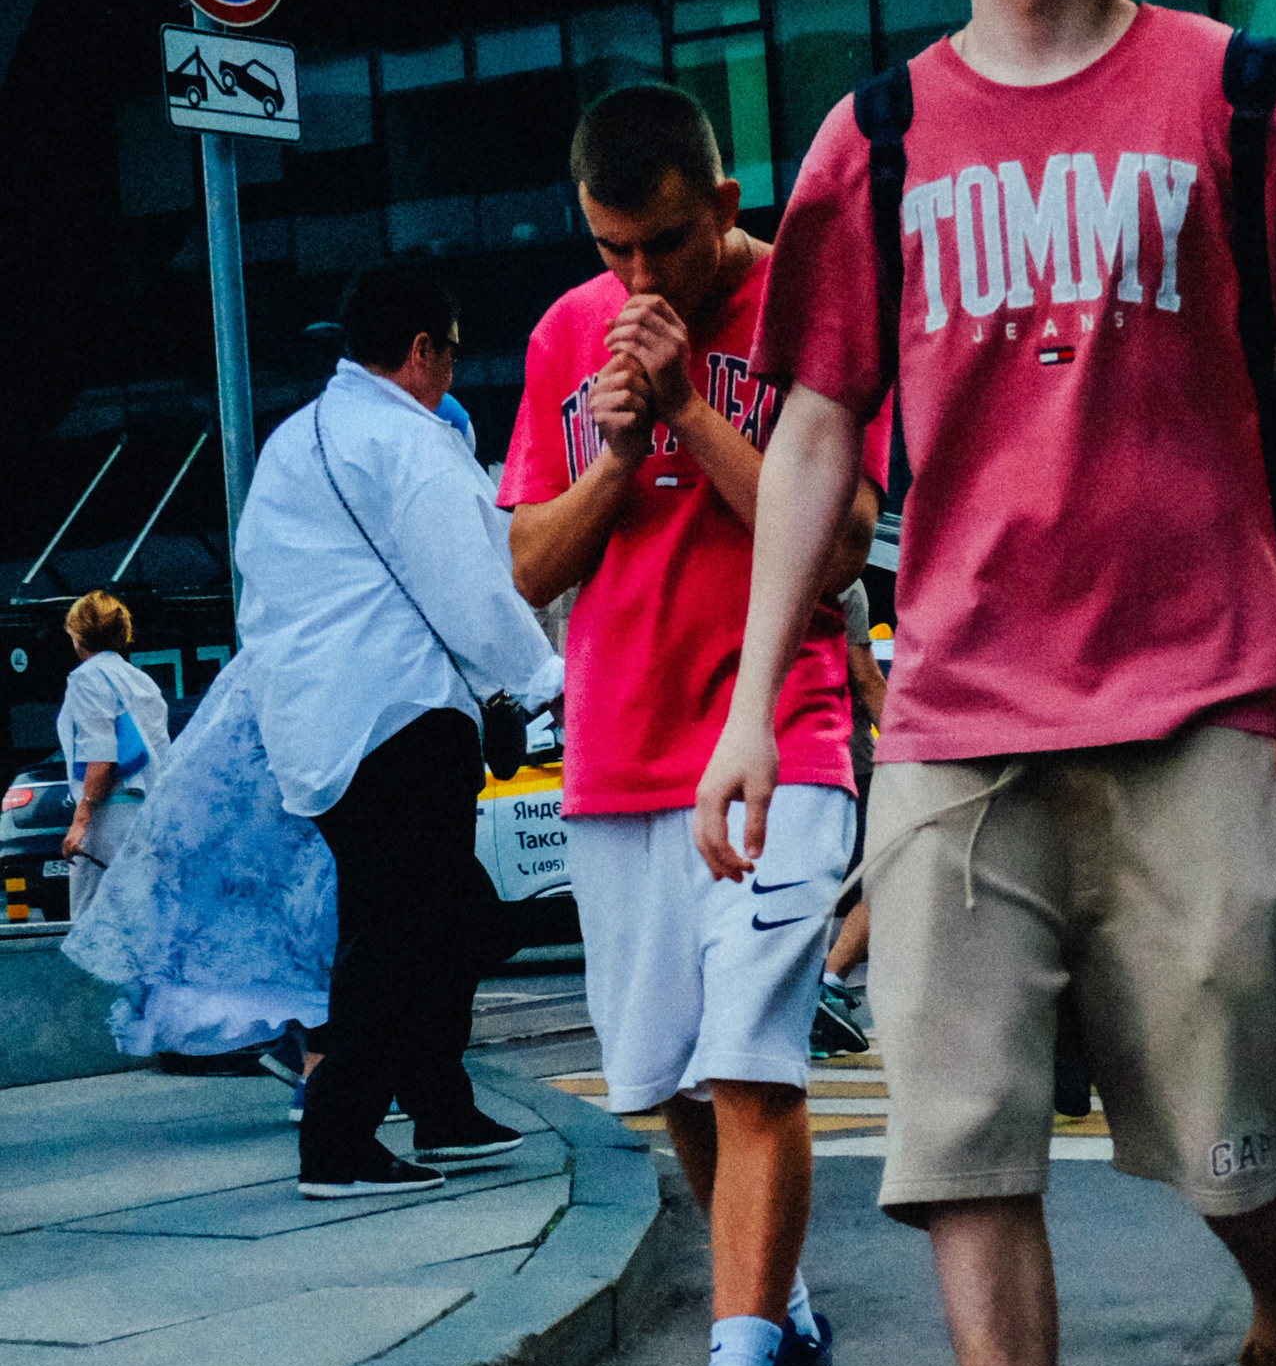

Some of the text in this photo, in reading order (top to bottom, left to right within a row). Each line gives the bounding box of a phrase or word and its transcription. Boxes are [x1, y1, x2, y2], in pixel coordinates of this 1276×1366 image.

[902, 152, 1198, 334] TOMMY
[972, 311, 1123, 343] JEANS
[532, 859, 565, 875] (495)
